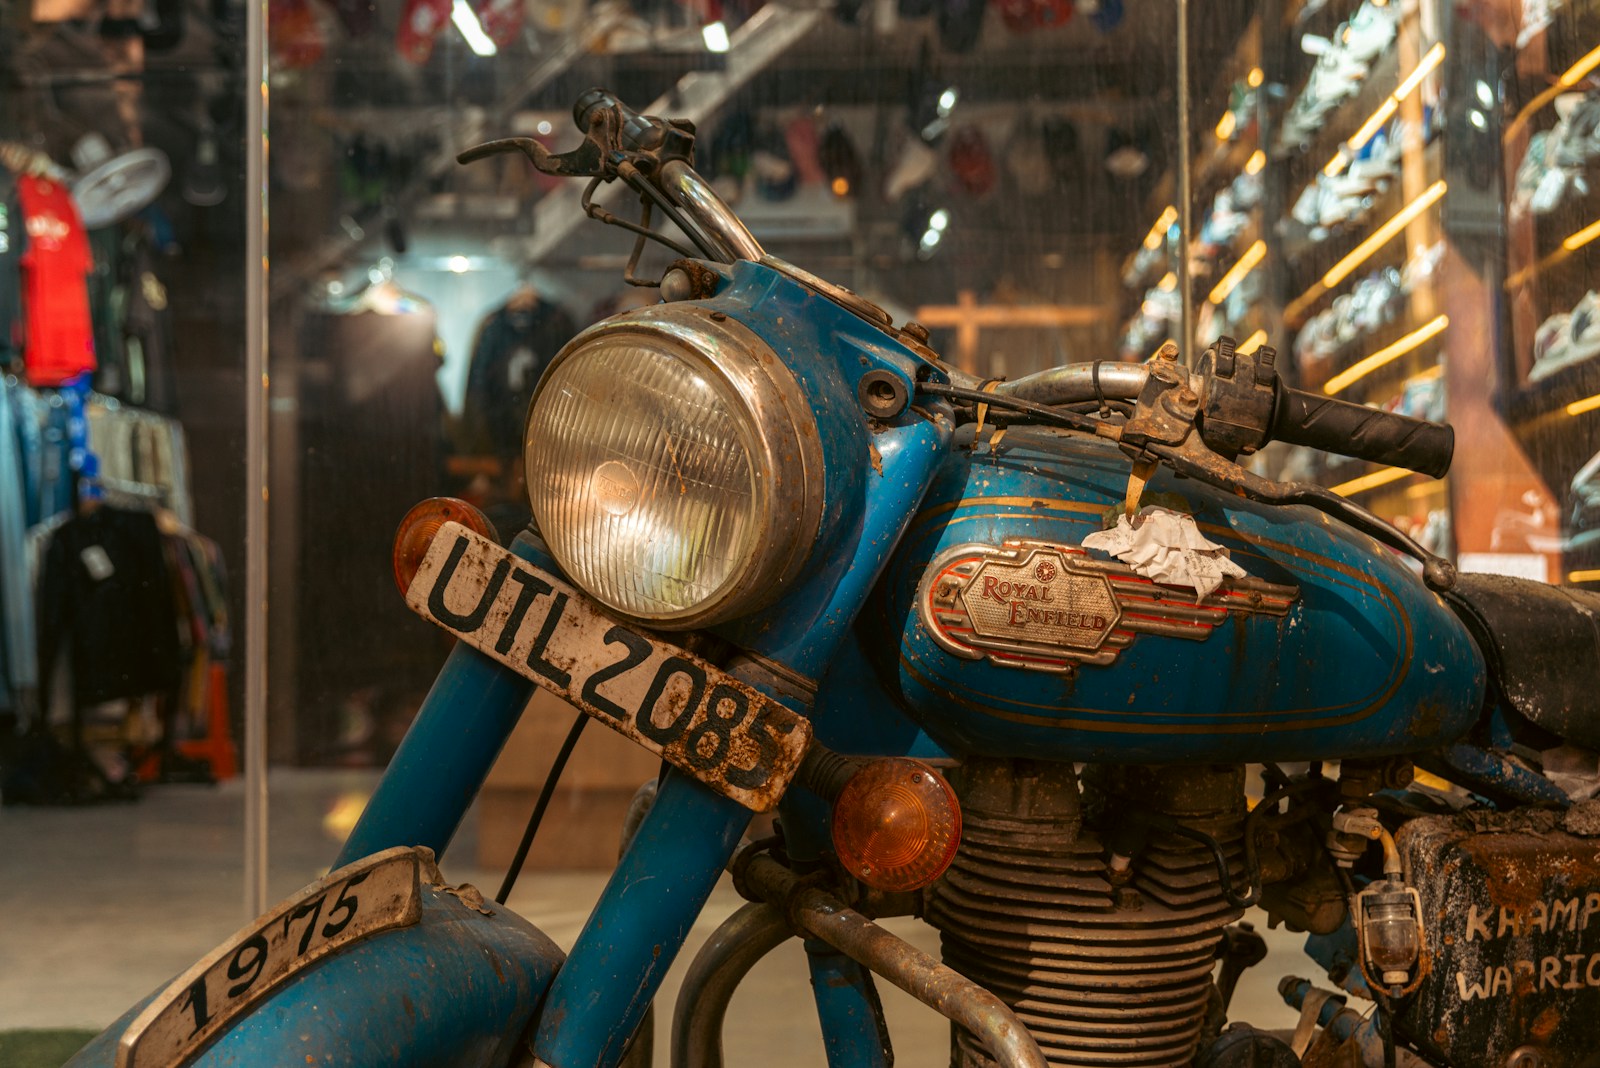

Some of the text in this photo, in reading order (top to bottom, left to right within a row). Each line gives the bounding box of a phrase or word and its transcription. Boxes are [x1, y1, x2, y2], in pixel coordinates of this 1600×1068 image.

[982, 575, 1054, 604] ROYAL
[1008, 600, 1106, 631] ENFIELD
[180, 869, 373, 1041] 1975
